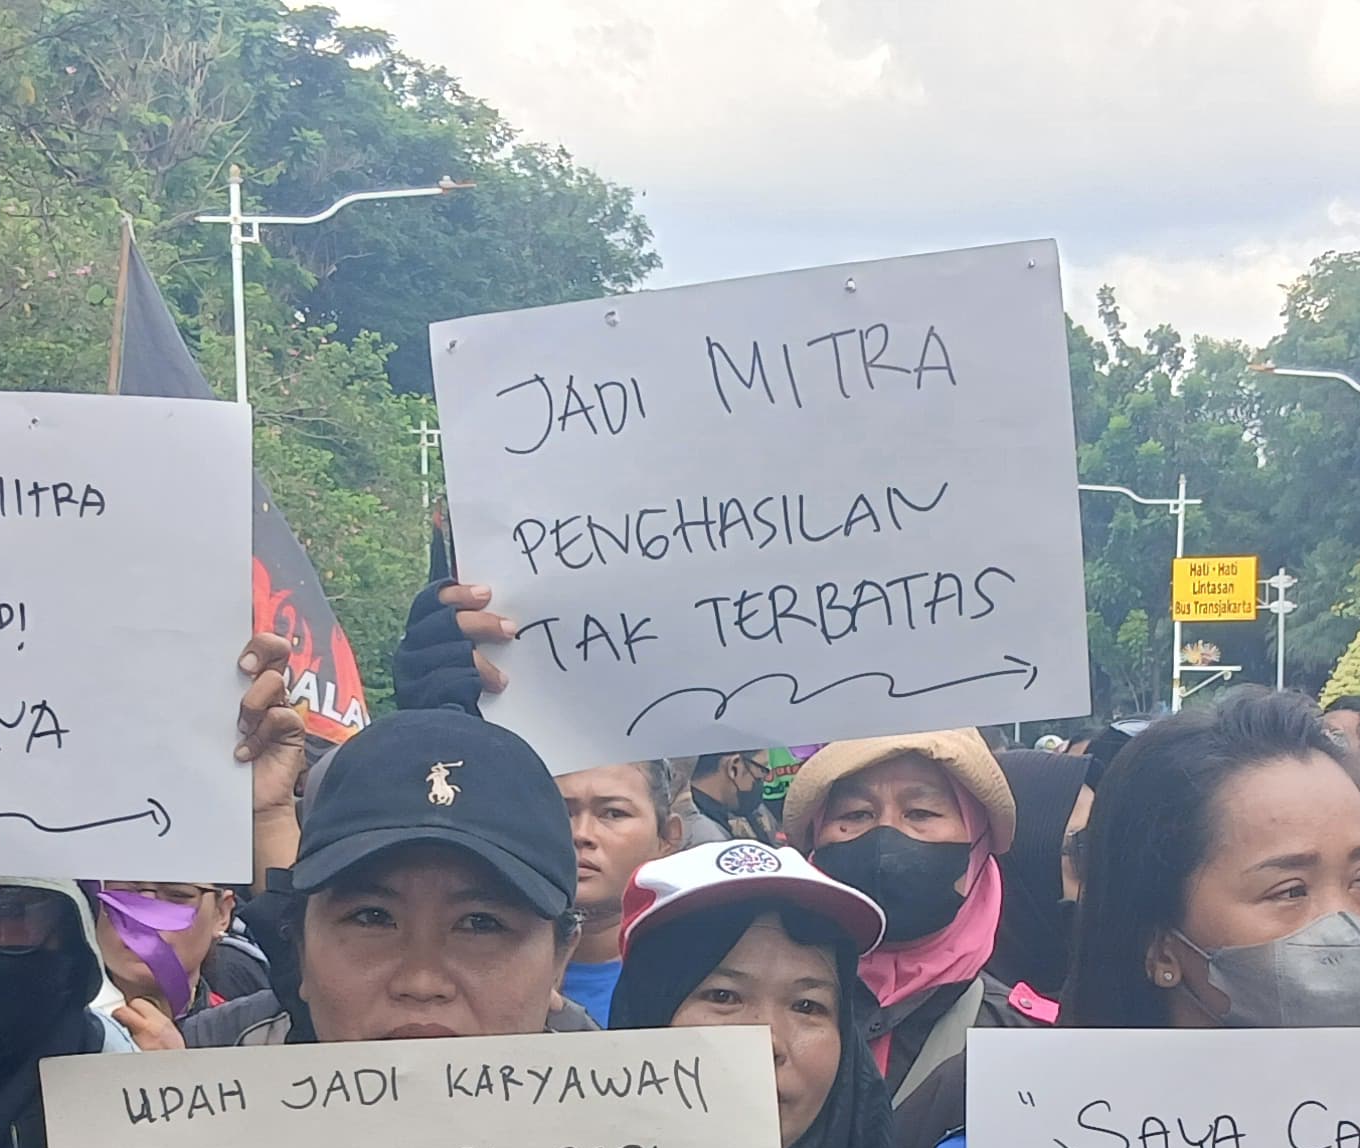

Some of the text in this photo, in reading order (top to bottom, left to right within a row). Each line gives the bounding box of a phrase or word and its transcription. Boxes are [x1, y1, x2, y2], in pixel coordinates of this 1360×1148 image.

[497, 322, 957, 455] JADI MITRA
[513, 482, 949, 575] PENGHASILAN
[515, 566, 1016, 673] TAK TERBATAS
[1175, 600, 1252, 617] Bus Transjakarta
[1193, 581, 1235, 595] Lintasan
[123, 1057, 709, 1125] UDAH JADI KARYAWAN
